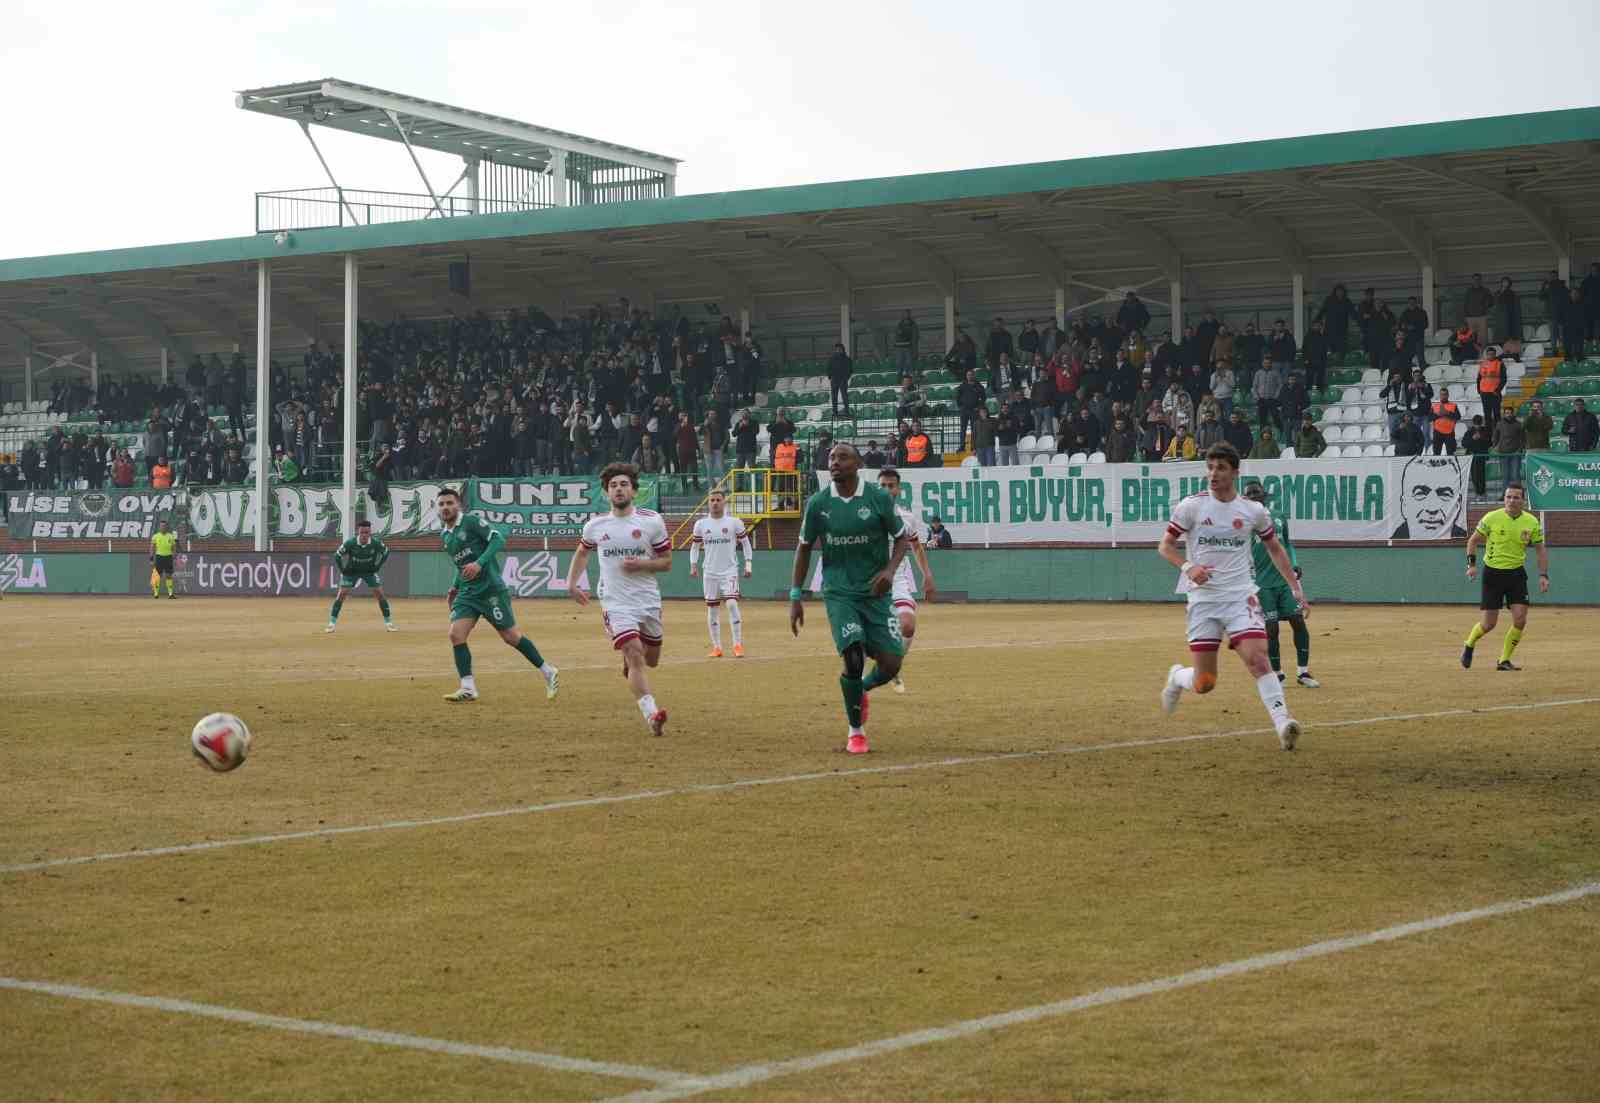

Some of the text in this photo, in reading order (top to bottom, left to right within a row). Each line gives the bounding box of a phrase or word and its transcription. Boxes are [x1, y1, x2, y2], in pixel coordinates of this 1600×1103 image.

[9, 492, 175, 513] LİSE OVA
[1009, 467, 1113, 528] BÜYÜR,
[1122, 466, 1170, 522] BİR
[32, 515, 154, 538] BEYLERİ
[833, 536, 869, 545] SOCAR
[196, 555, 311, 595] trendyol
[492, 606, 504, 621] 6
